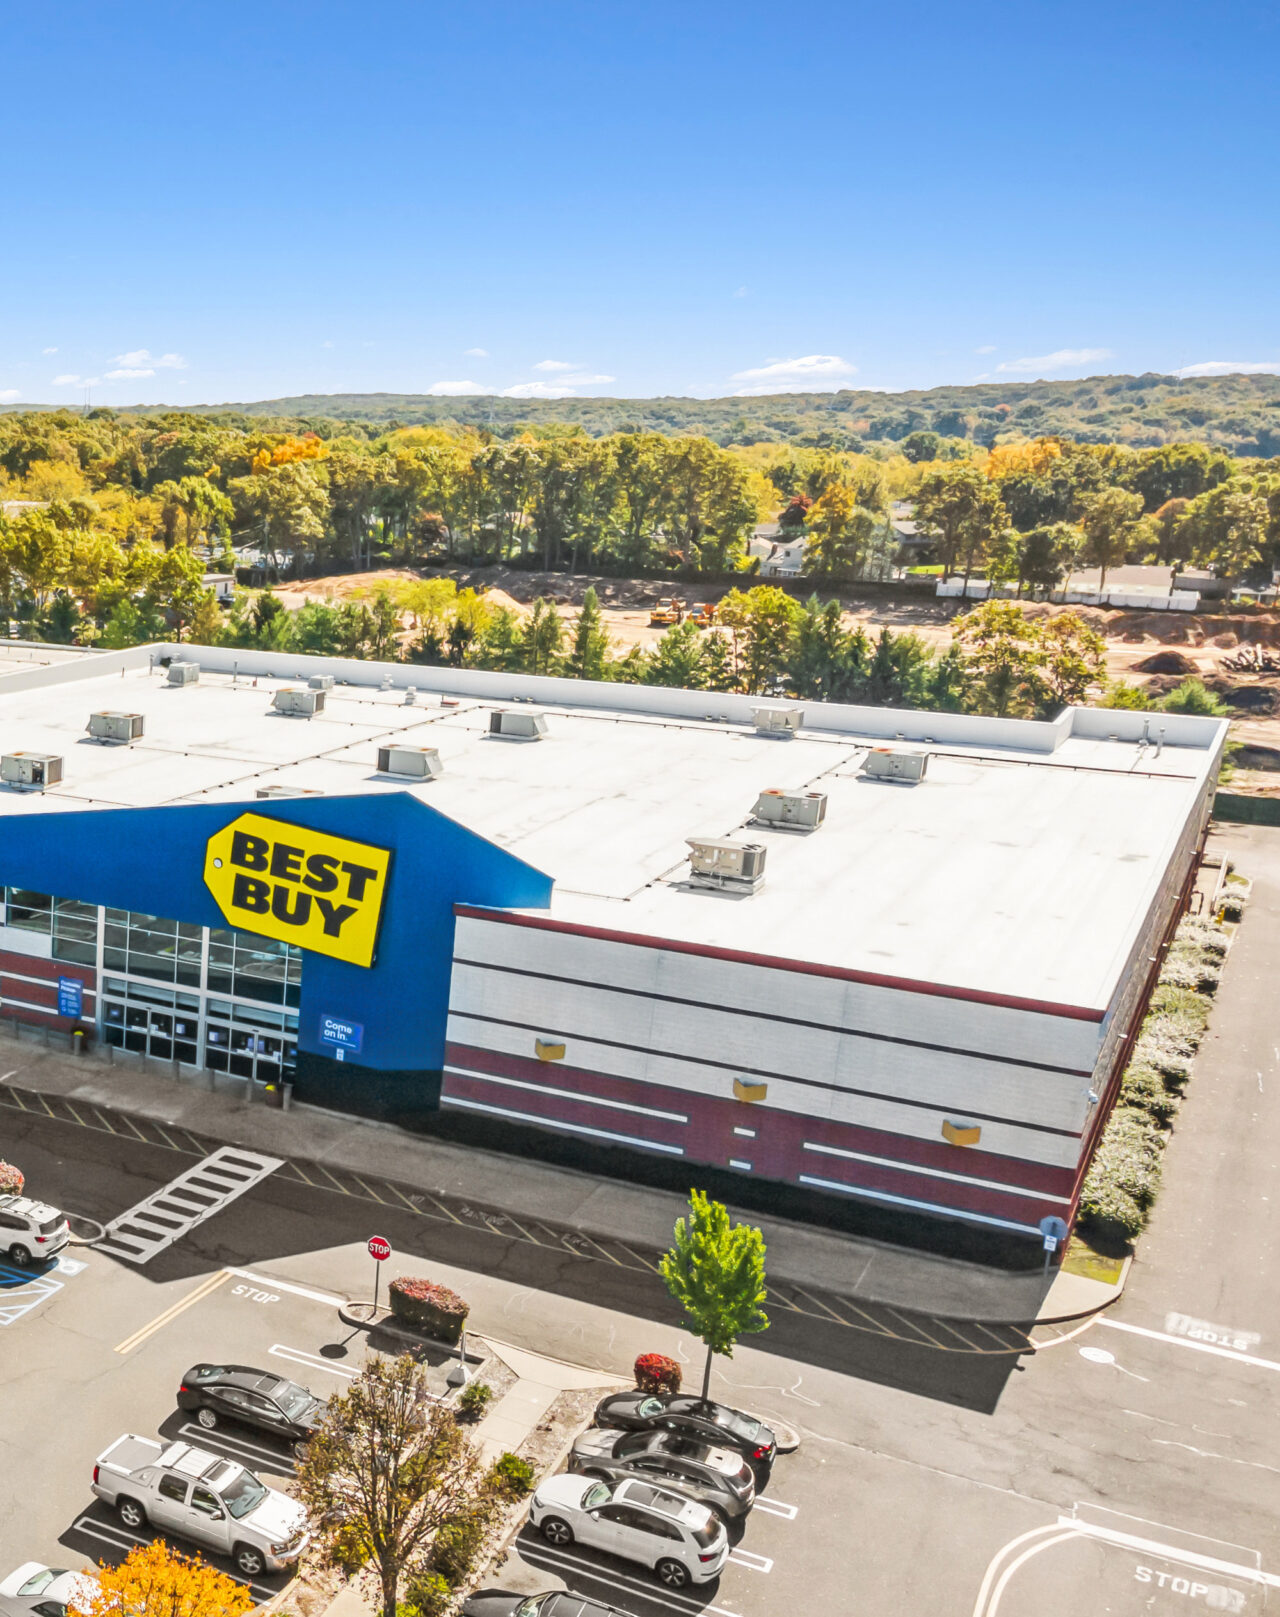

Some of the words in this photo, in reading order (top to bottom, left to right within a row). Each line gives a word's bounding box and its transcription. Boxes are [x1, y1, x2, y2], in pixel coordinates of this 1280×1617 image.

[230, 830, 378, 902] BEST
[231, 872, 359, 938] BUY
[323, 1029, 336, 1038] on
[325, 1019, 353, 1034] Come
[369, 1242, 390, 1255] STOP
[231, 1284, 281, 1304] STOP
[1134, 1565, 1209, 1598] STOP
